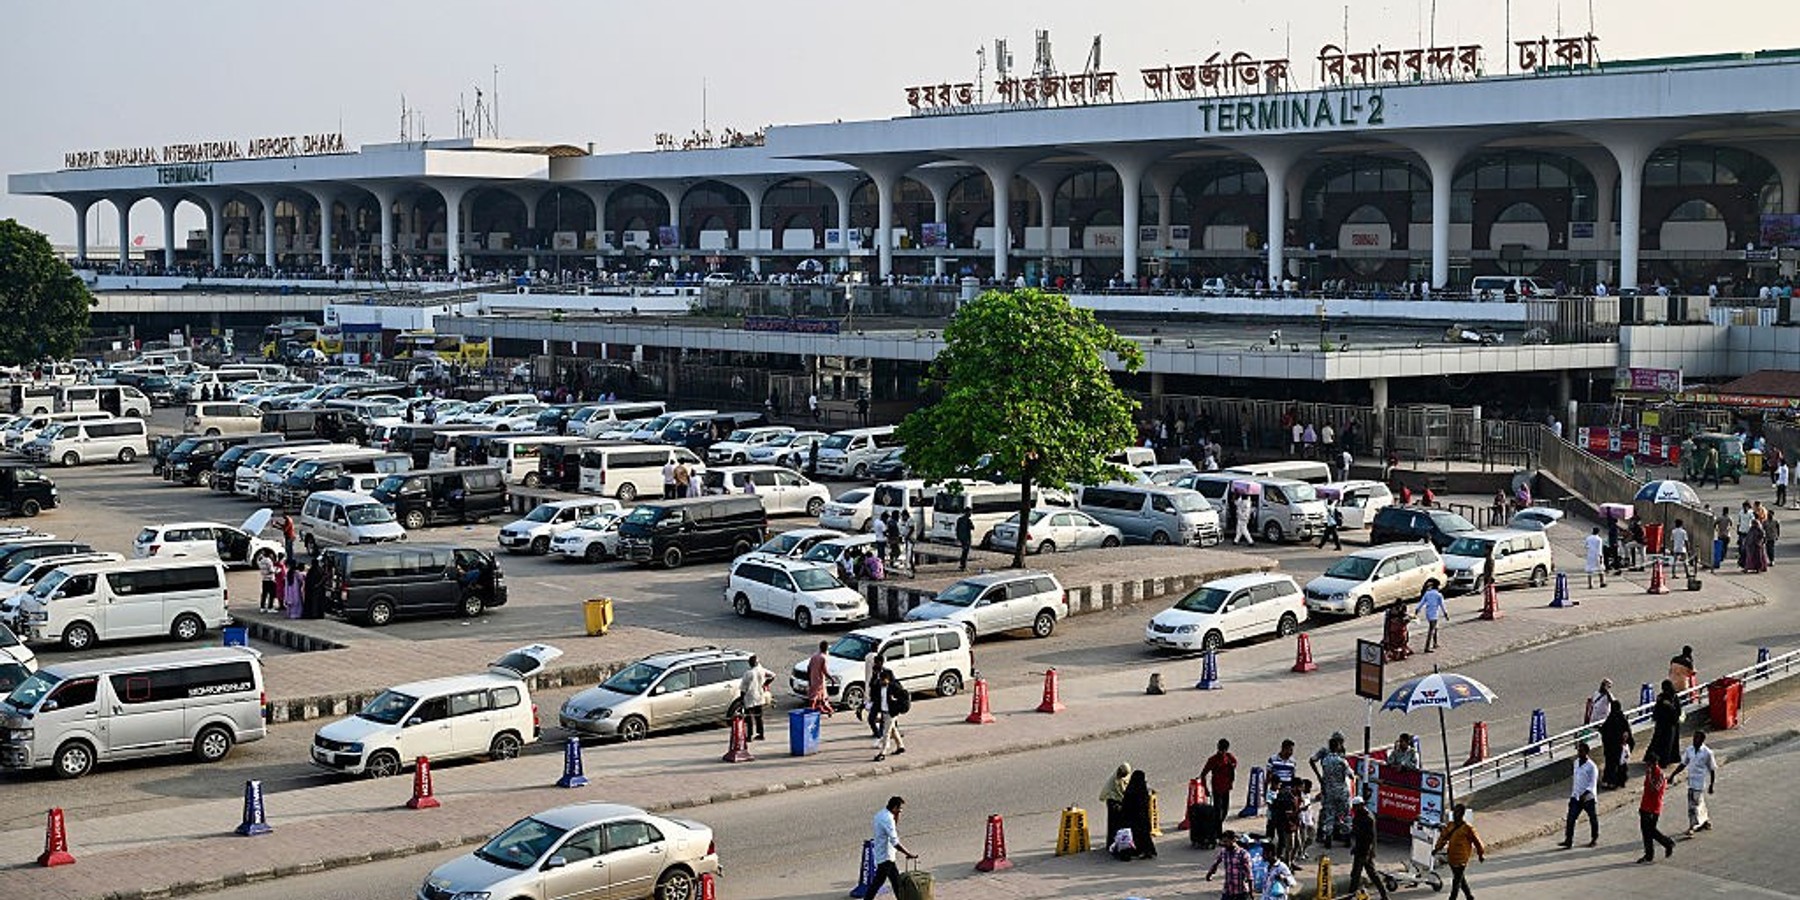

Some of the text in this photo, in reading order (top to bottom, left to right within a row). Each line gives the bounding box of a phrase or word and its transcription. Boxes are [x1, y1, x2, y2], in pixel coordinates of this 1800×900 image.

[904, 31, 1599, 110] হযরত শাহজালাল আন্তর্জাতিক বিমানবন্দর ঢাকা
[1198, 94, 1383, 133] TERMINAL-2
[64, 131, 344, 168] HAZRAT SHAHJALAL INTERNATIONAL AIRPORT DHAKA
[156, 163, 213, 184] TERMINAL-1
[1411, 697, 1448, 706] WALTON
[421, 762, 430, 797] WALTON
[1062, 816, 1073, 852] WALTON
[862, 847, 870, 886] WALTON
[1322, 864, 1330, 897] WALTON
